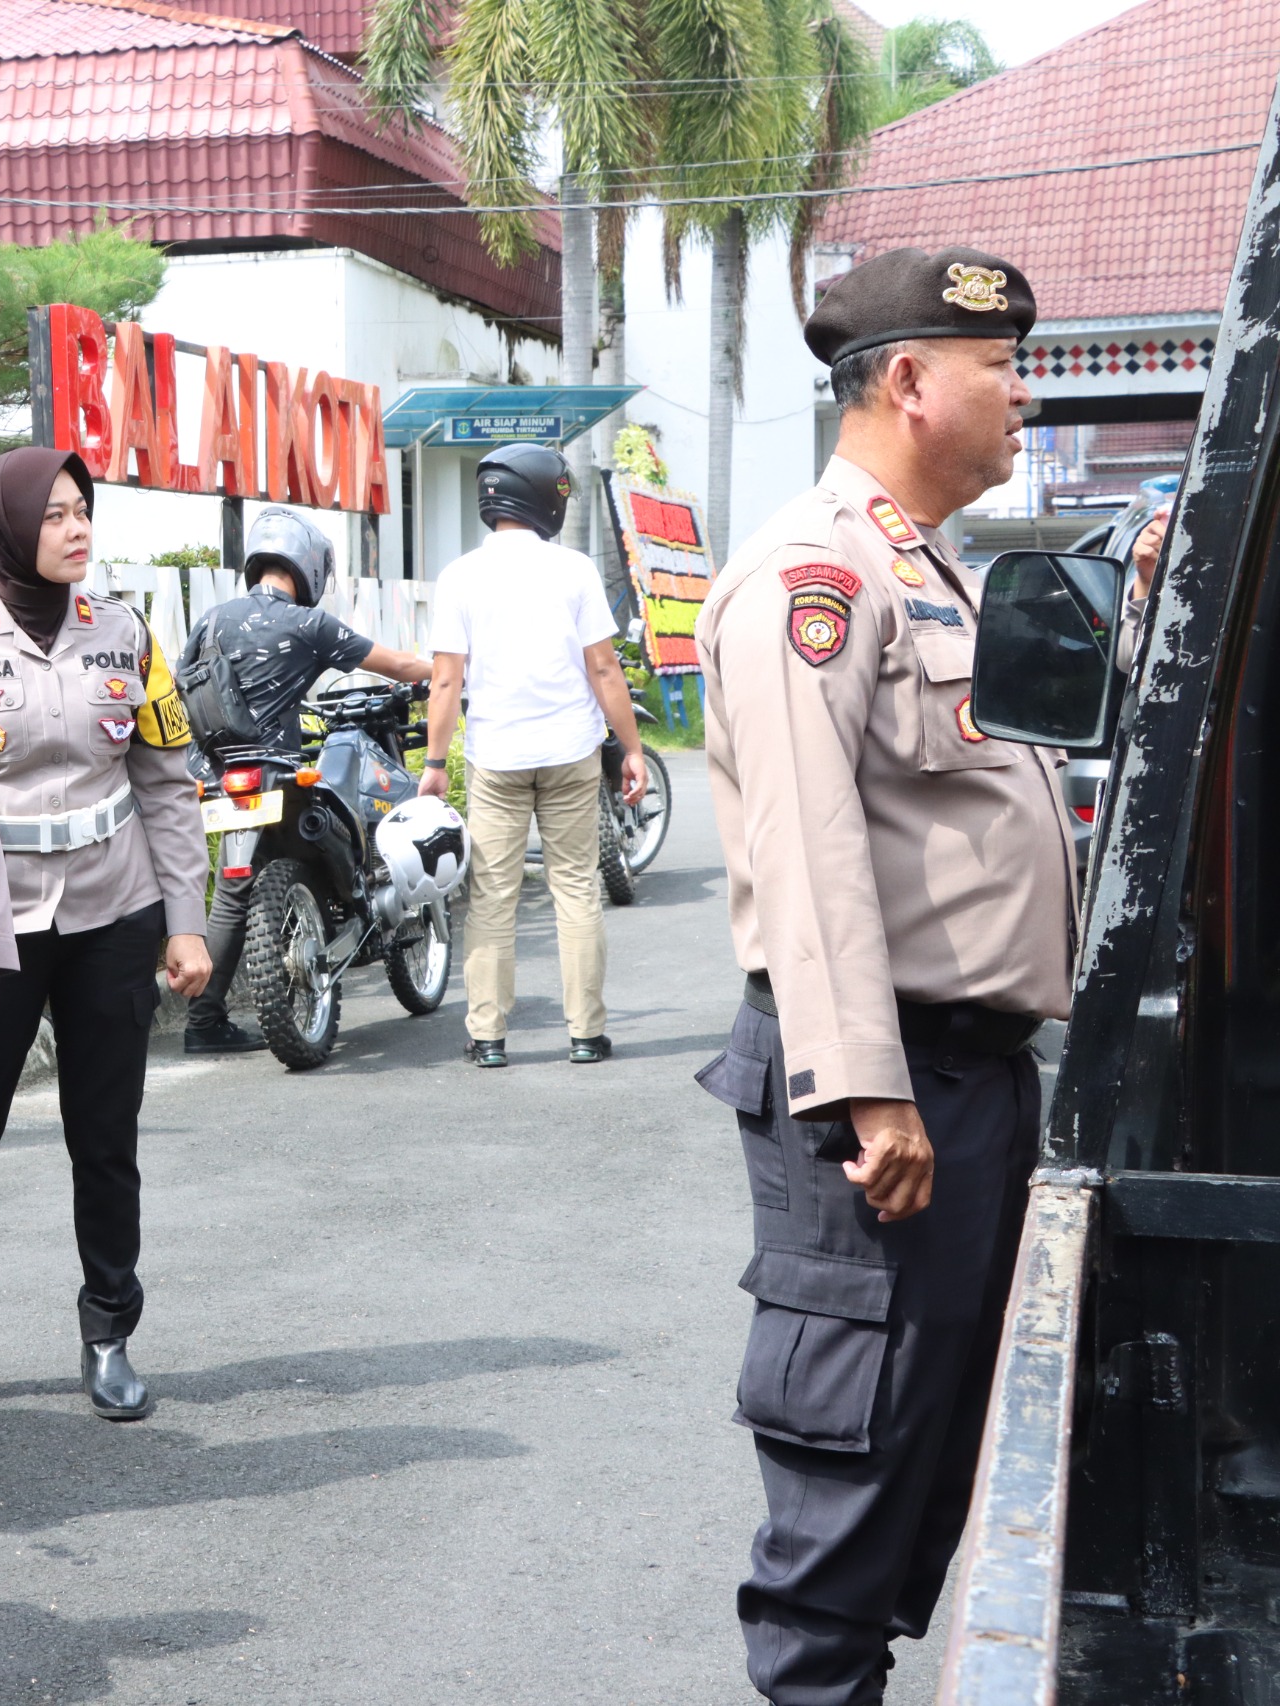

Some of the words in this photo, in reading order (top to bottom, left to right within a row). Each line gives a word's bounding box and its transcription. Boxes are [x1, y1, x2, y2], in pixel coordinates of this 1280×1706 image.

[473, 419, 491, 427] AIR
[494, 418, 517, 427] SIAP
[520, 418, 554, 427] MINUM
[789, 568, 808, 582] SAT
[810, 567, 855, 590] SAMAPTA
[794, 595, 819, 606] KORPS
[819, 596, 847, 615] SABHARA
[81, 651, 135, 671] POLRI
